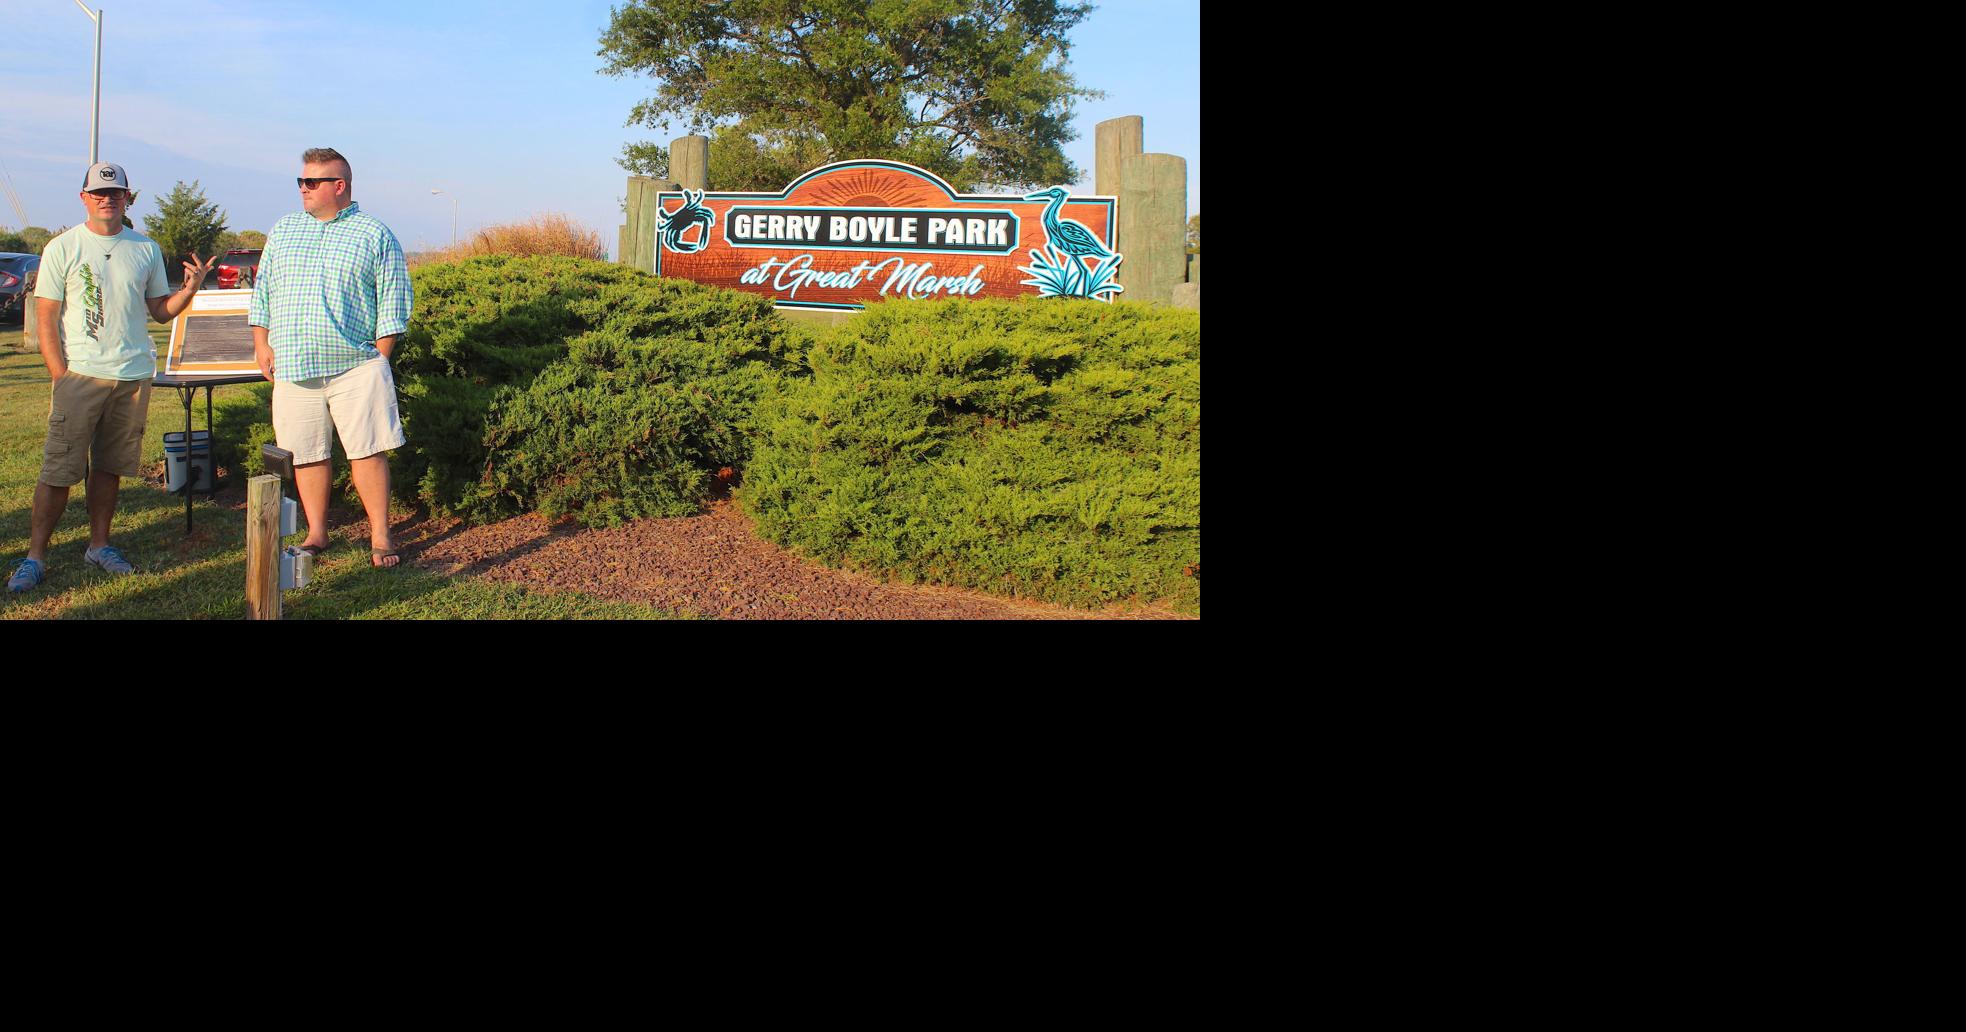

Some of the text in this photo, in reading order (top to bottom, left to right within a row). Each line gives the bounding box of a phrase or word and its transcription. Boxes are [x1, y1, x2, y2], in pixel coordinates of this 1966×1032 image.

[734, 213, 1009, 247] GERRY BOYLE PARK
[740, 253, 985, 300] at Great Marsh
